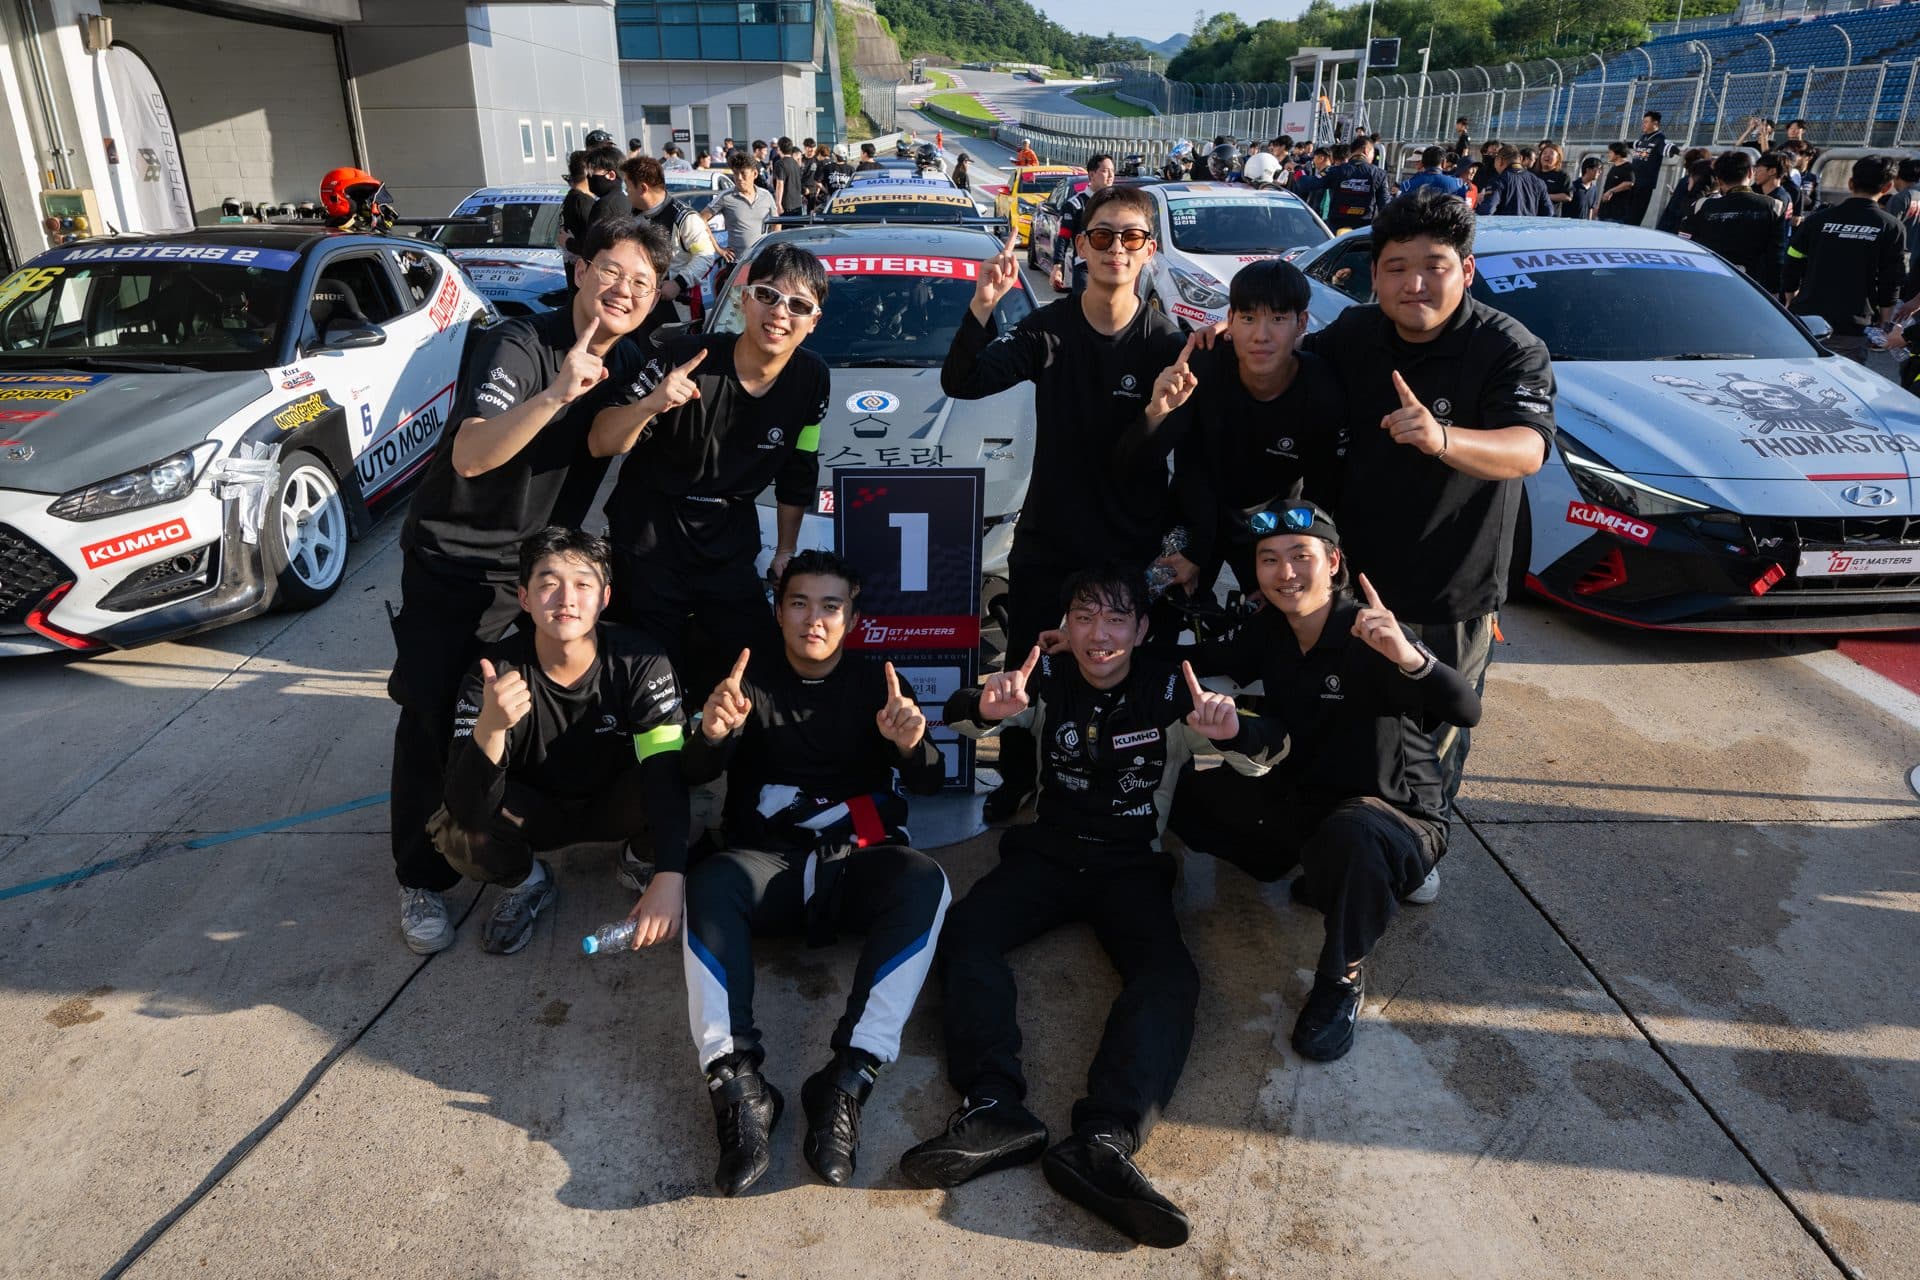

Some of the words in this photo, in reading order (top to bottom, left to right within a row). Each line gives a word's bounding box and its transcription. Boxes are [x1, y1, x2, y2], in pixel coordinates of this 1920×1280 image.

[482, 194, 562, 204] MASTERS
[839, 195, 913, 205] MASTERS
[1823, 222, 1843, 233] PIT
[1841, 224, 1881, 234] STOP
[63, 245, 226, 262] MASTERS
[231, 250, 260, 262] 2
[1513, 250, 1663, 269] MASTERS
[1681, 255, 1698, 268] N
[818, 257, 953, 274] STERS
[962, 262, 976, 277] 1
[1490, 273, 1538, 294] 64
[1173, 305, 1205, 320] KUMHO
[477, 393, 509, 411] ROWE
[361, 402, 373, 437] 6
[354, 440, 397, 488] AUTO
[399, 406, 443, 457] MOBIL
[818, 446, 952, 468] 스토랑
[1569, 506, 1650, 540] KUMHO
[88, 521, 186, 565] KUMHO
[888, 512, 929, 592] 1
[1867, 557, 1913, 565] MASTERS
[888, 628, 903, 636] GT
[904, 627, 956, 636] MASTERS
[913, 683, 937, 695] 인제
[1114, 730, 1158, 747] KUMHO
